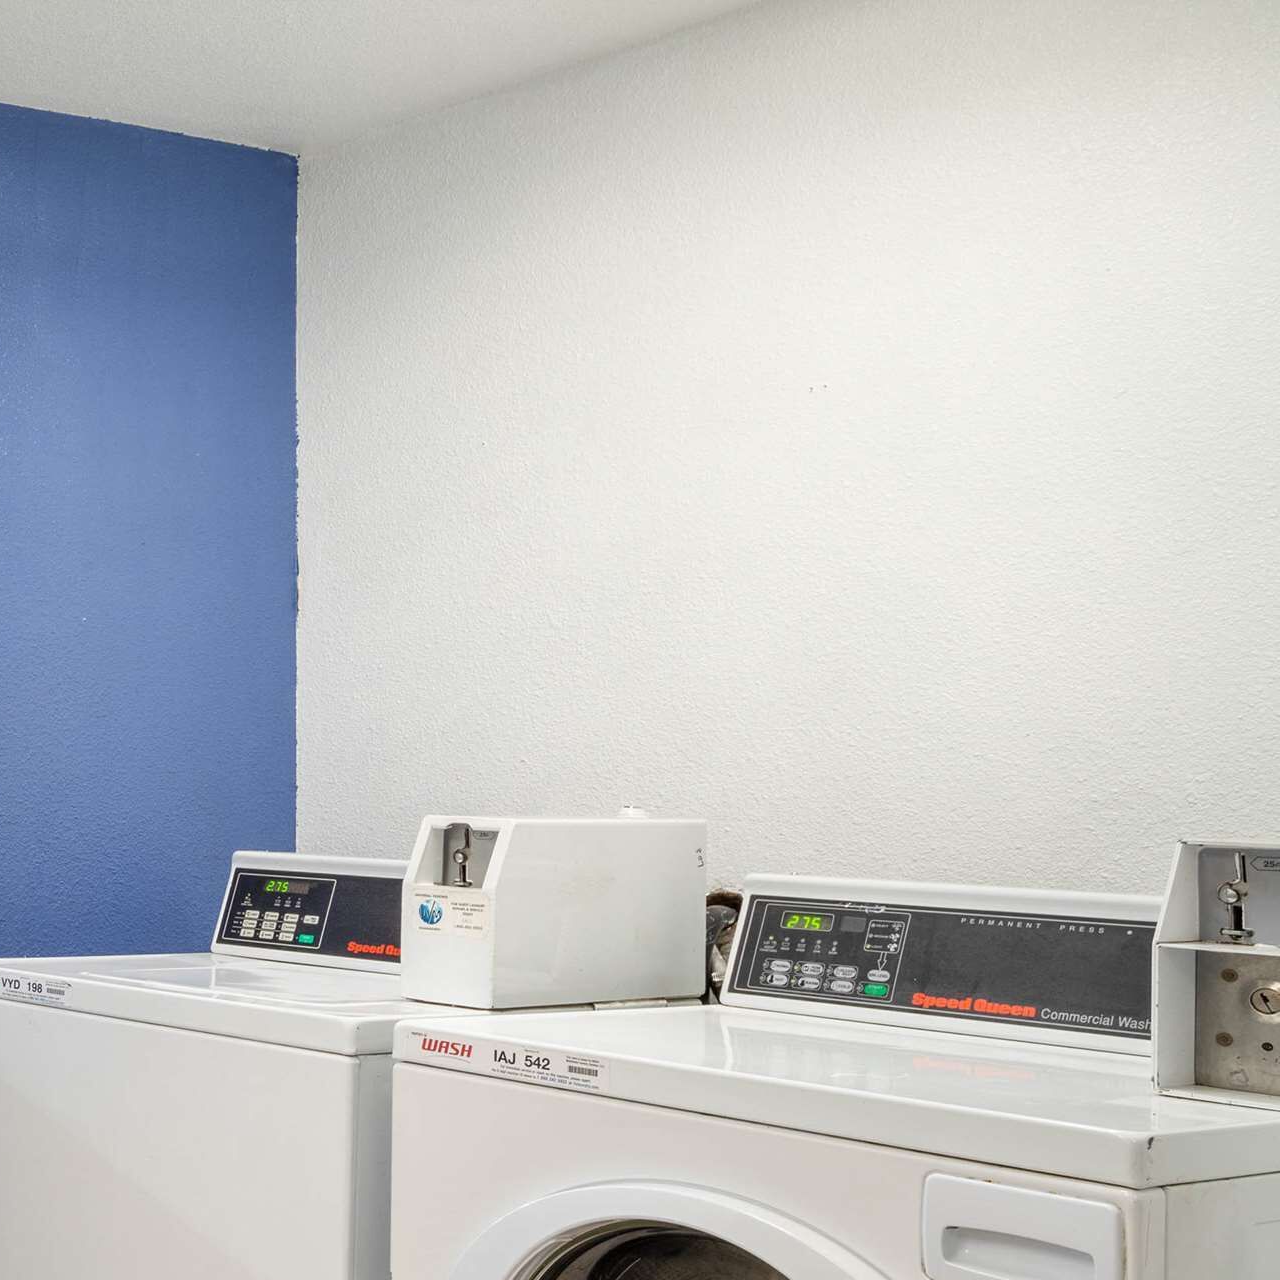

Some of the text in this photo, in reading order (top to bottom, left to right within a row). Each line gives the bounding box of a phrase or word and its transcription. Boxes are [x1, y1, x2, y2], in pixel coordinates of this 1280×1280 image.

[961, 917, 1105, 934] PERMANENT PRESS
[346, 940, 385, 954] Speed
[1, 977, 21, 989] VYD
[27, 982, 43, 993] 198
[911, 992, 972, 1010] Speed
[973, 999, 1037, 1018] Queen
[1040, 1007, 1115, 1027] Commercial
[421, 1037, 473, 1058] WASH
[494, 1049, 516, 1065] IAJ
[524, 1055, 551, 1071] 542
